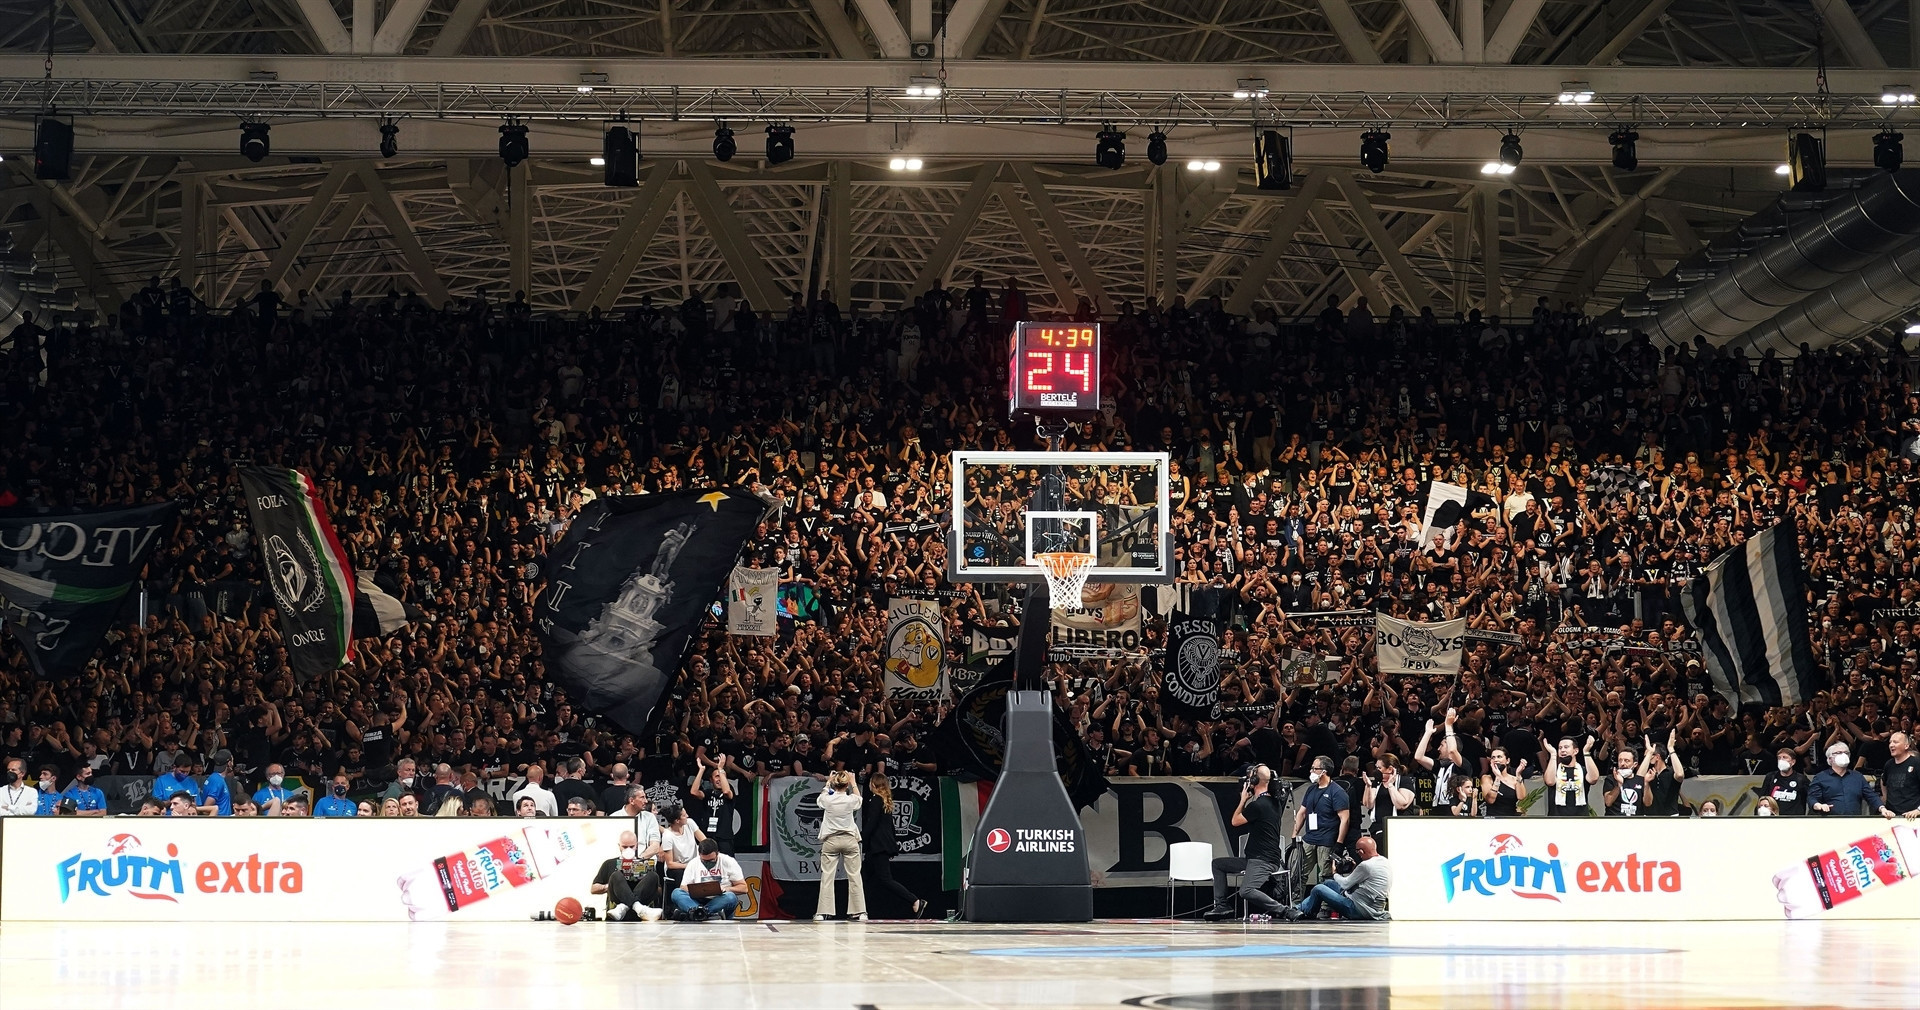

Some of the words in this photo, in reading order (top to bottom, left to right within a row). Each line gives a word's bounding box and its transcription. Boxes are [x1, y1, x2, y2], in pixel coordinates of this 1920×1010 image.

[1040, 328, 1093, 348] 4:39
[1027, 352, 1090, 392] 24
[1052, 626, 1139, 651] LIBERO
[1015, 841, 1075, 852] AIRLINES
[1016, 829, 1074, 841] TURKISH
[195, 852, 303, 894] extra
[466, 859, 485, 890] extra
[700, 868, 723, 876] NASA
[1576, 852, 1682, 893] extra
[1839, 858, 1857, 888] extra
